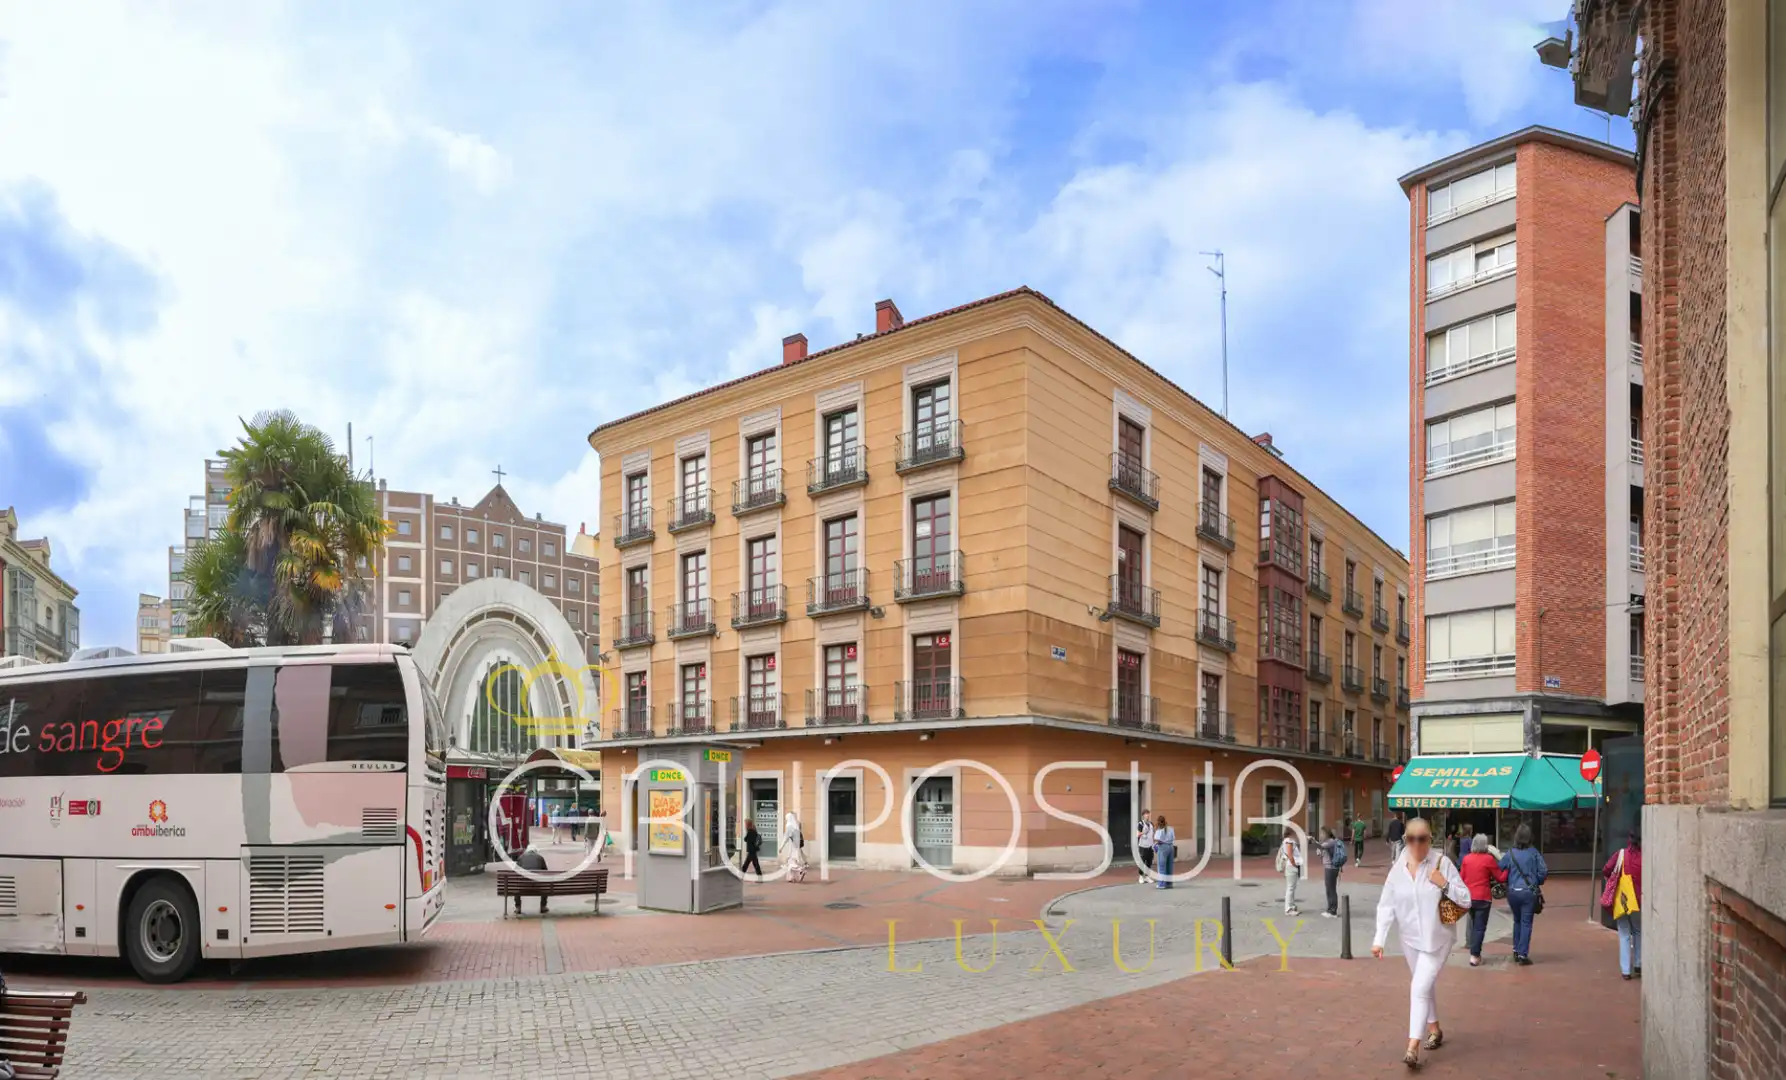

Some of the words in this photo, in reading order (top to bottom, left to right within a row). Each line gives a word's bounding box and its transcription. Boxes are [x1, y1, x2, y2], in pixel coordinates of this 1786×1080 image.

[0, 697, 31, 754] de
[38, 715, 164, 772] sangre
[711, 751, 729, 760] ONCE
[659, 771, 683, 780] ONCE
[1410, 766, 1513, 777] SEMILLAS
[1430, 778, 1480, 788] FITO
[1396, 798, 1448, 808] SEVERO
[1451, 798, 1501, 808] FRAILE
